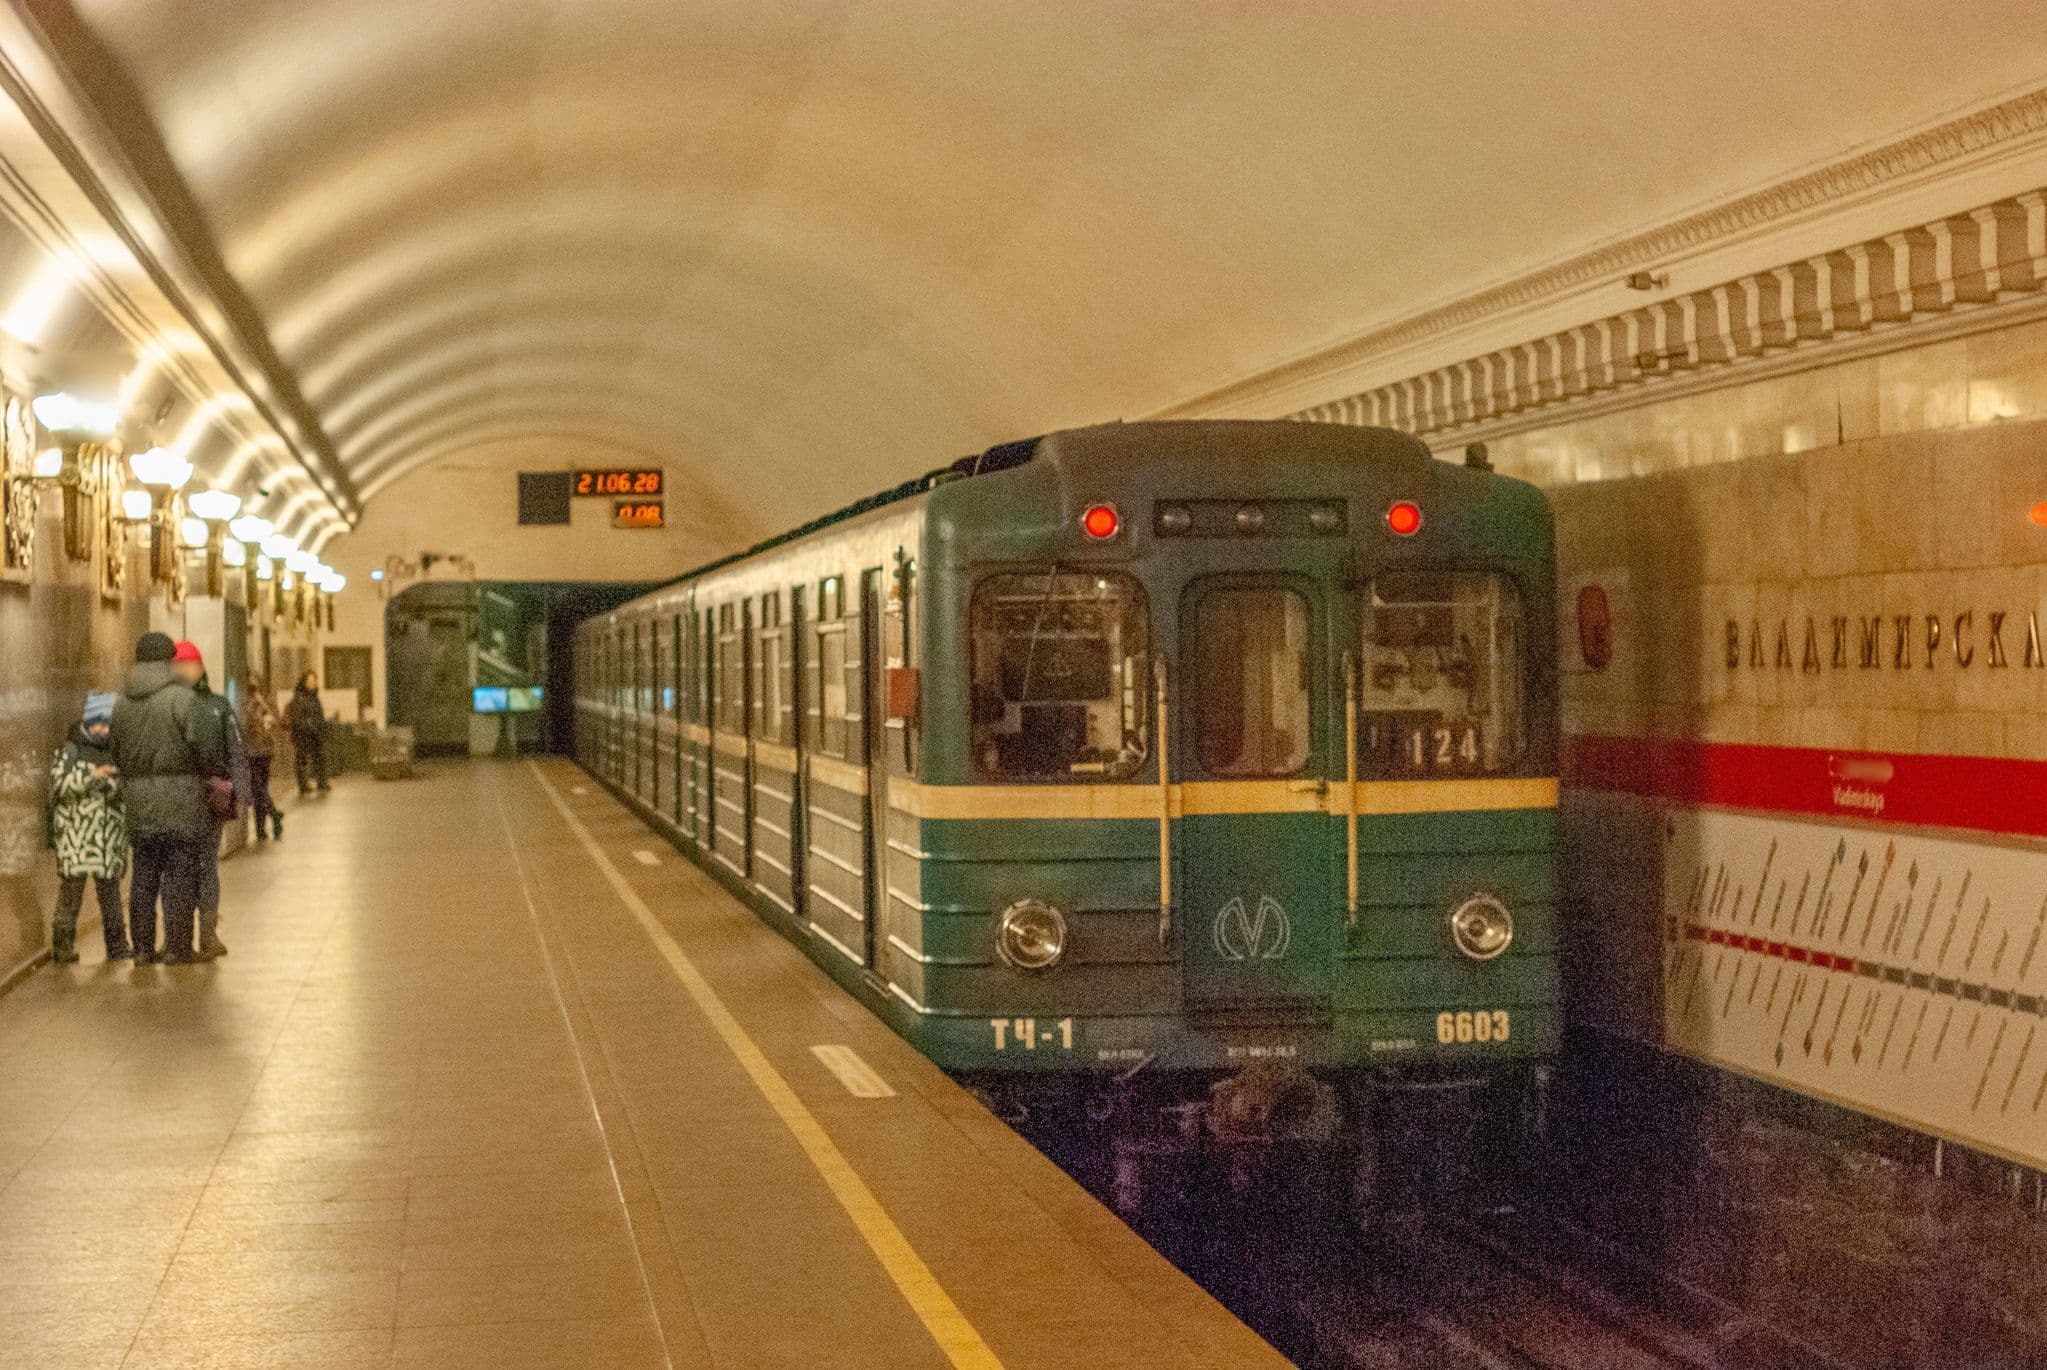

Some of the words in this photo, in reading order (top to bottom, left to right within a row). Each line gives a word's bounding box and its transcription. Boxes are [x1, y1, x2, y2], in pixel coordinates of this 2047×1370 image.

[1412, 728, 1478, 765] 124
[991, 1018, 1072, 1049] ТЧ-1
[1436, 1010, 1510, 1043] 6603
